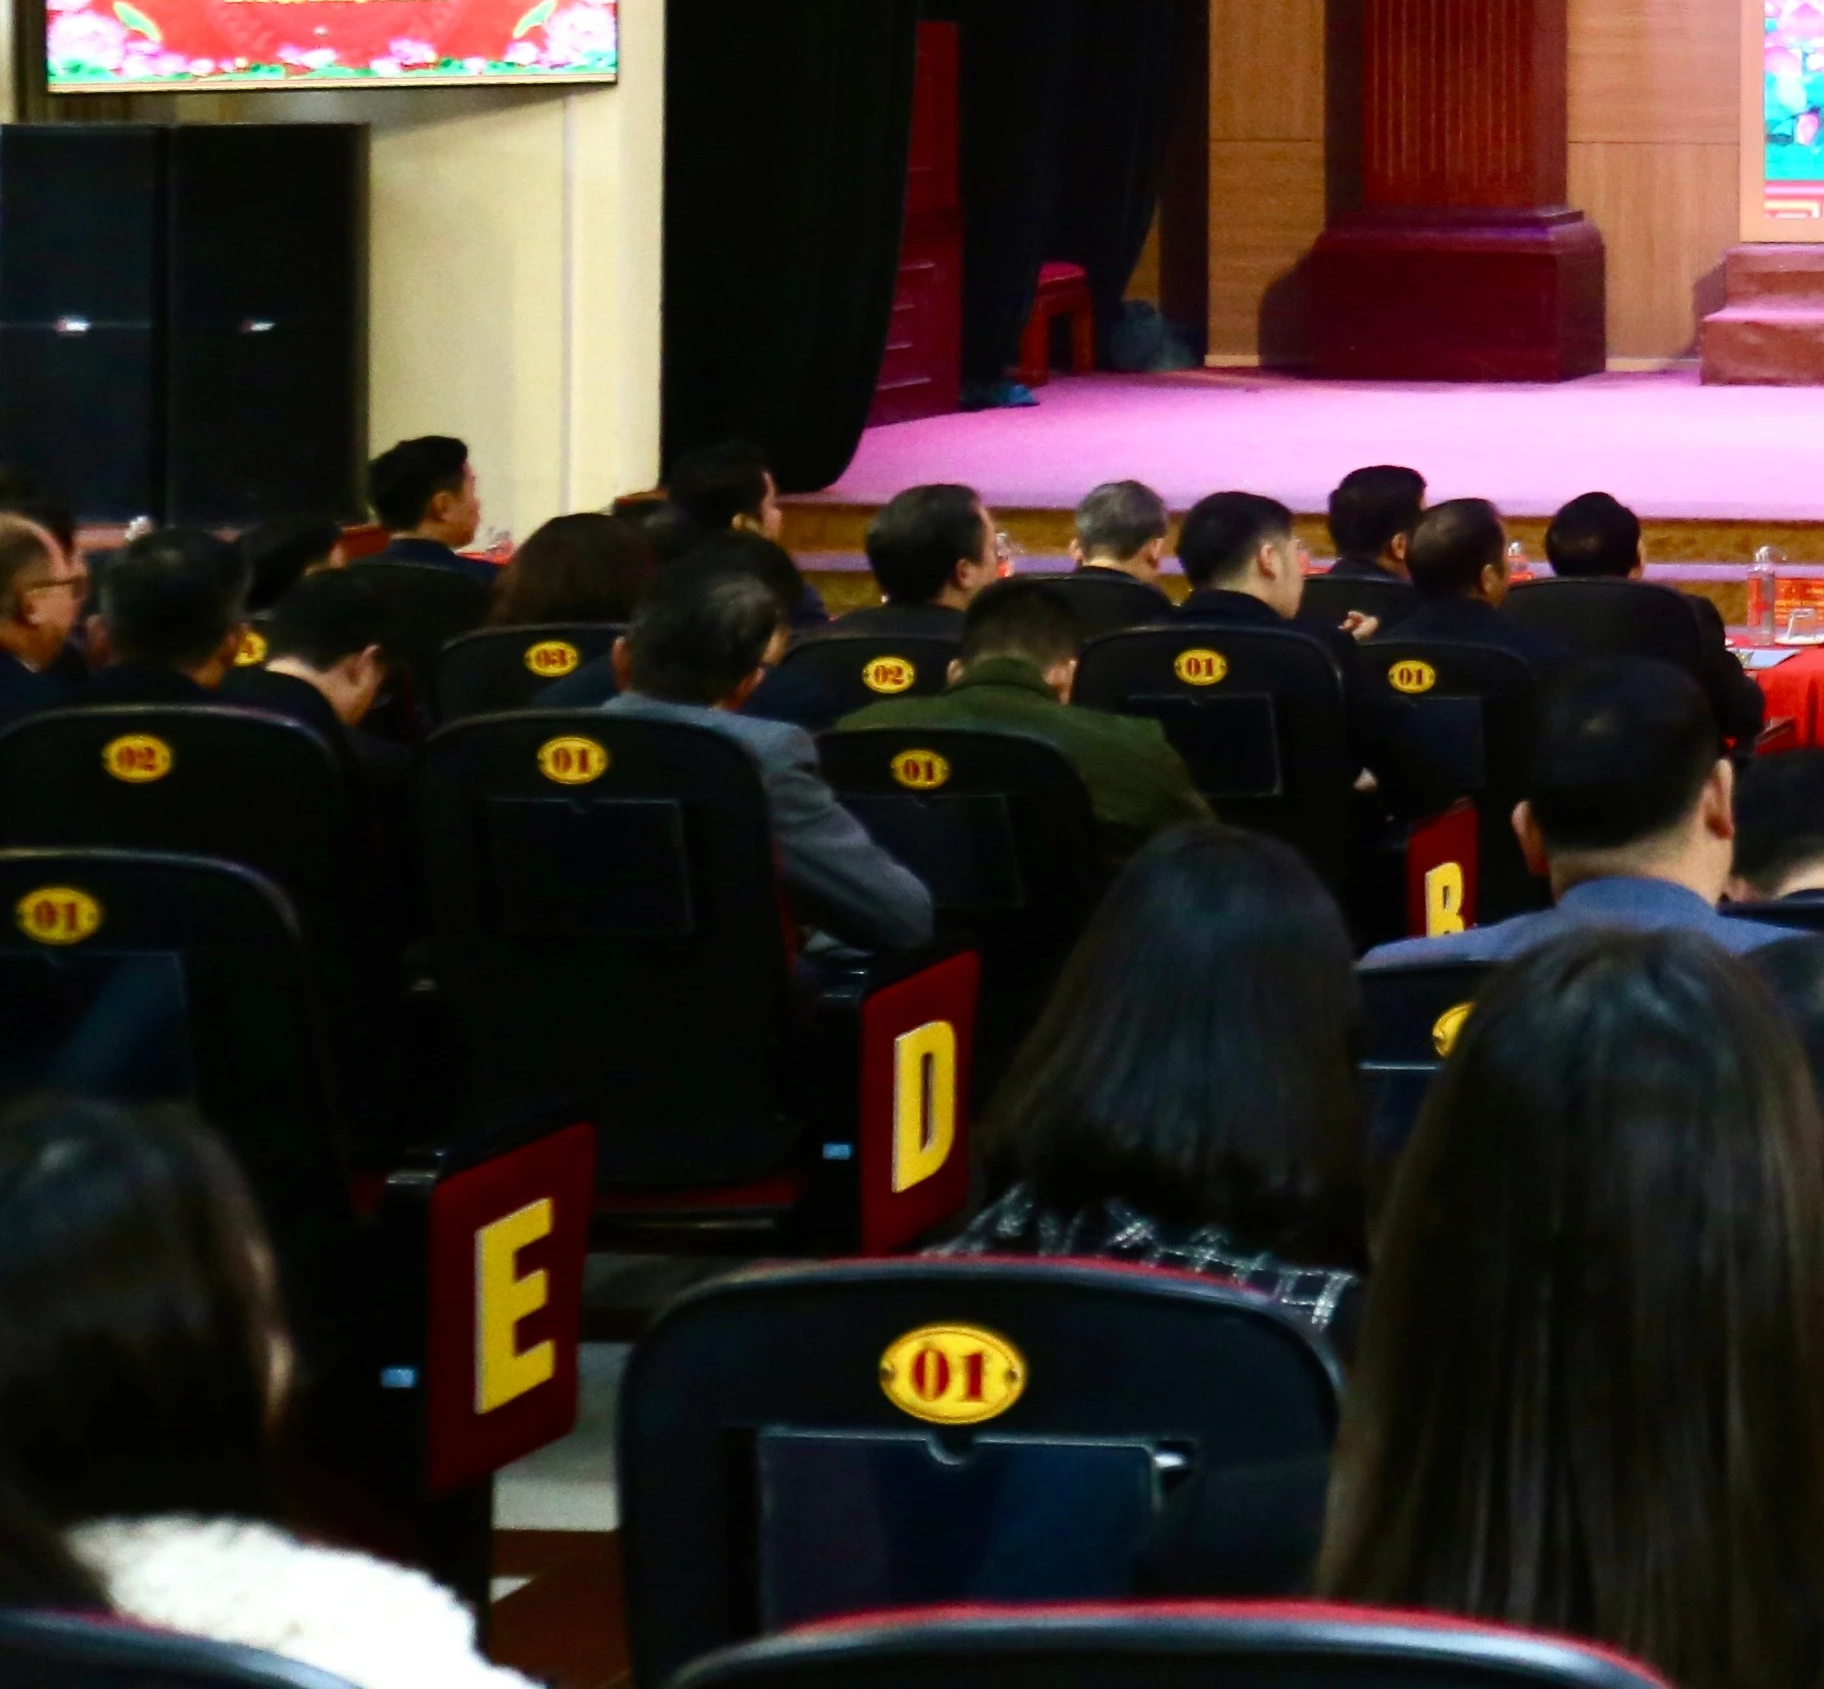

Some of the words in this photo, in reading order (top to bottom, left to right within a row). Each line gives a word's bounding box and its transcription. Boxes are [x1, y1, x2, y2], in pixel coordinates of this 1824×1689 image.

[874, 666, 904, 686] 02
[1186, 657, 1214, 677] 01
[1398, 668, 1423, 686] 01
[552, 747, 590, 774] 01
[902, 759, 935, 782] 01
[33, 900, 79, 933] 01
[892, 1019, 958, 1193] D
[474, 1196, 556, 1415] E
[910, 1345, 986, 1403] 01
